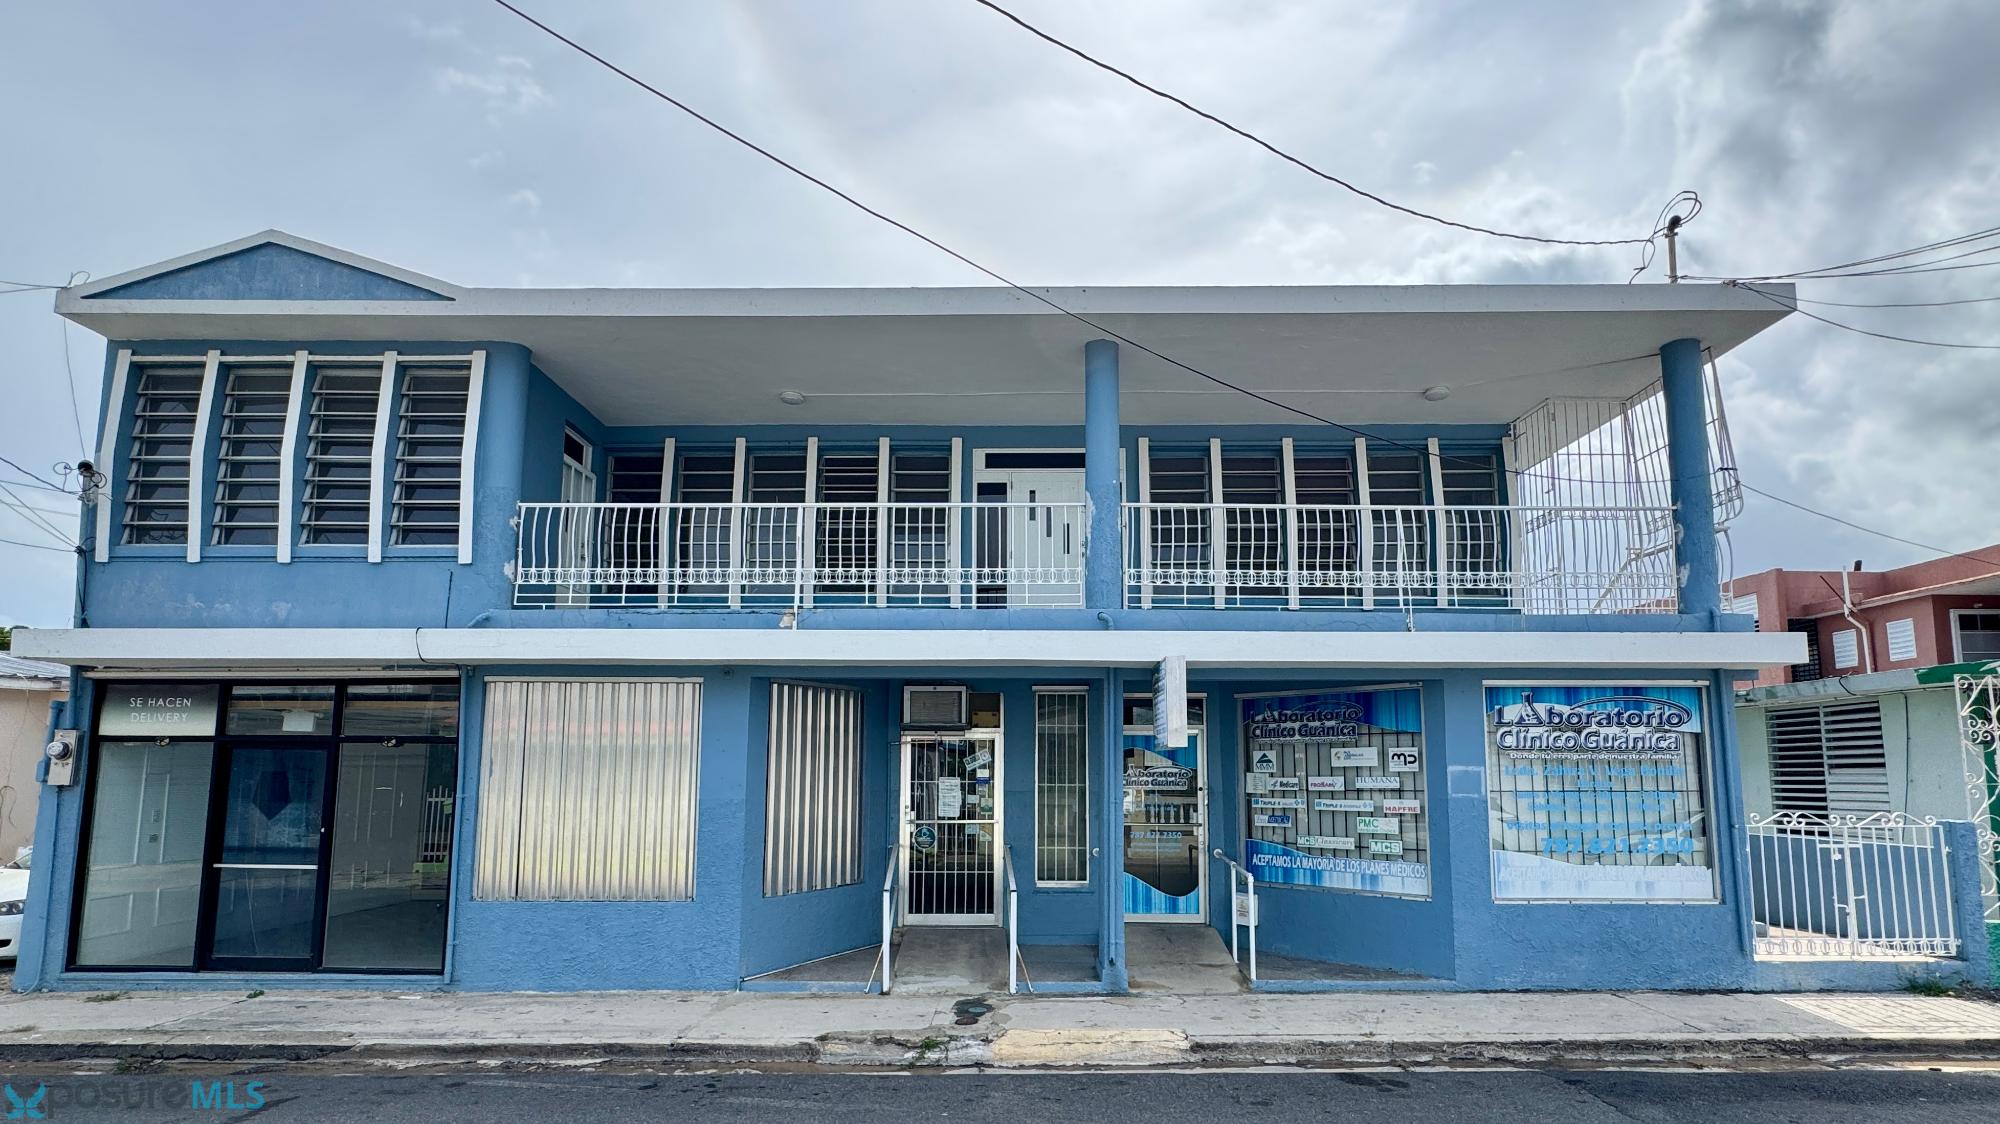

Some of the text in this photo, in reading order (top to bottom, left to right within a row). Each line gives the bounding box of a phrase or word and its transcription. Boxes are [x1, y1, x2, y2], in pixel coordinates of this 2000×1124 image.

[130, 697, 192, 707] SE HACEN
[131, 712, 188, 722] DELIVERY
[1298, 721, 1355, 737] Guánica
[1580, 728, 1681, 750] Guánica
[1356, 776, 1399, 784] HUMANA
[1358, 818, 1379, 828] PMC
[1297, 836, 1315, 845] MCS
[1370, 841, 1400, 853] MCS
[1252, 853, 1291, 868] ACEPTAMOS
[1292, 857, 1301, 868] LA
[1335, 859, 1346, 872] DE
[1346, 860, 1360, 873] LOS
[1361, 861, 1389, 875] PLANES
